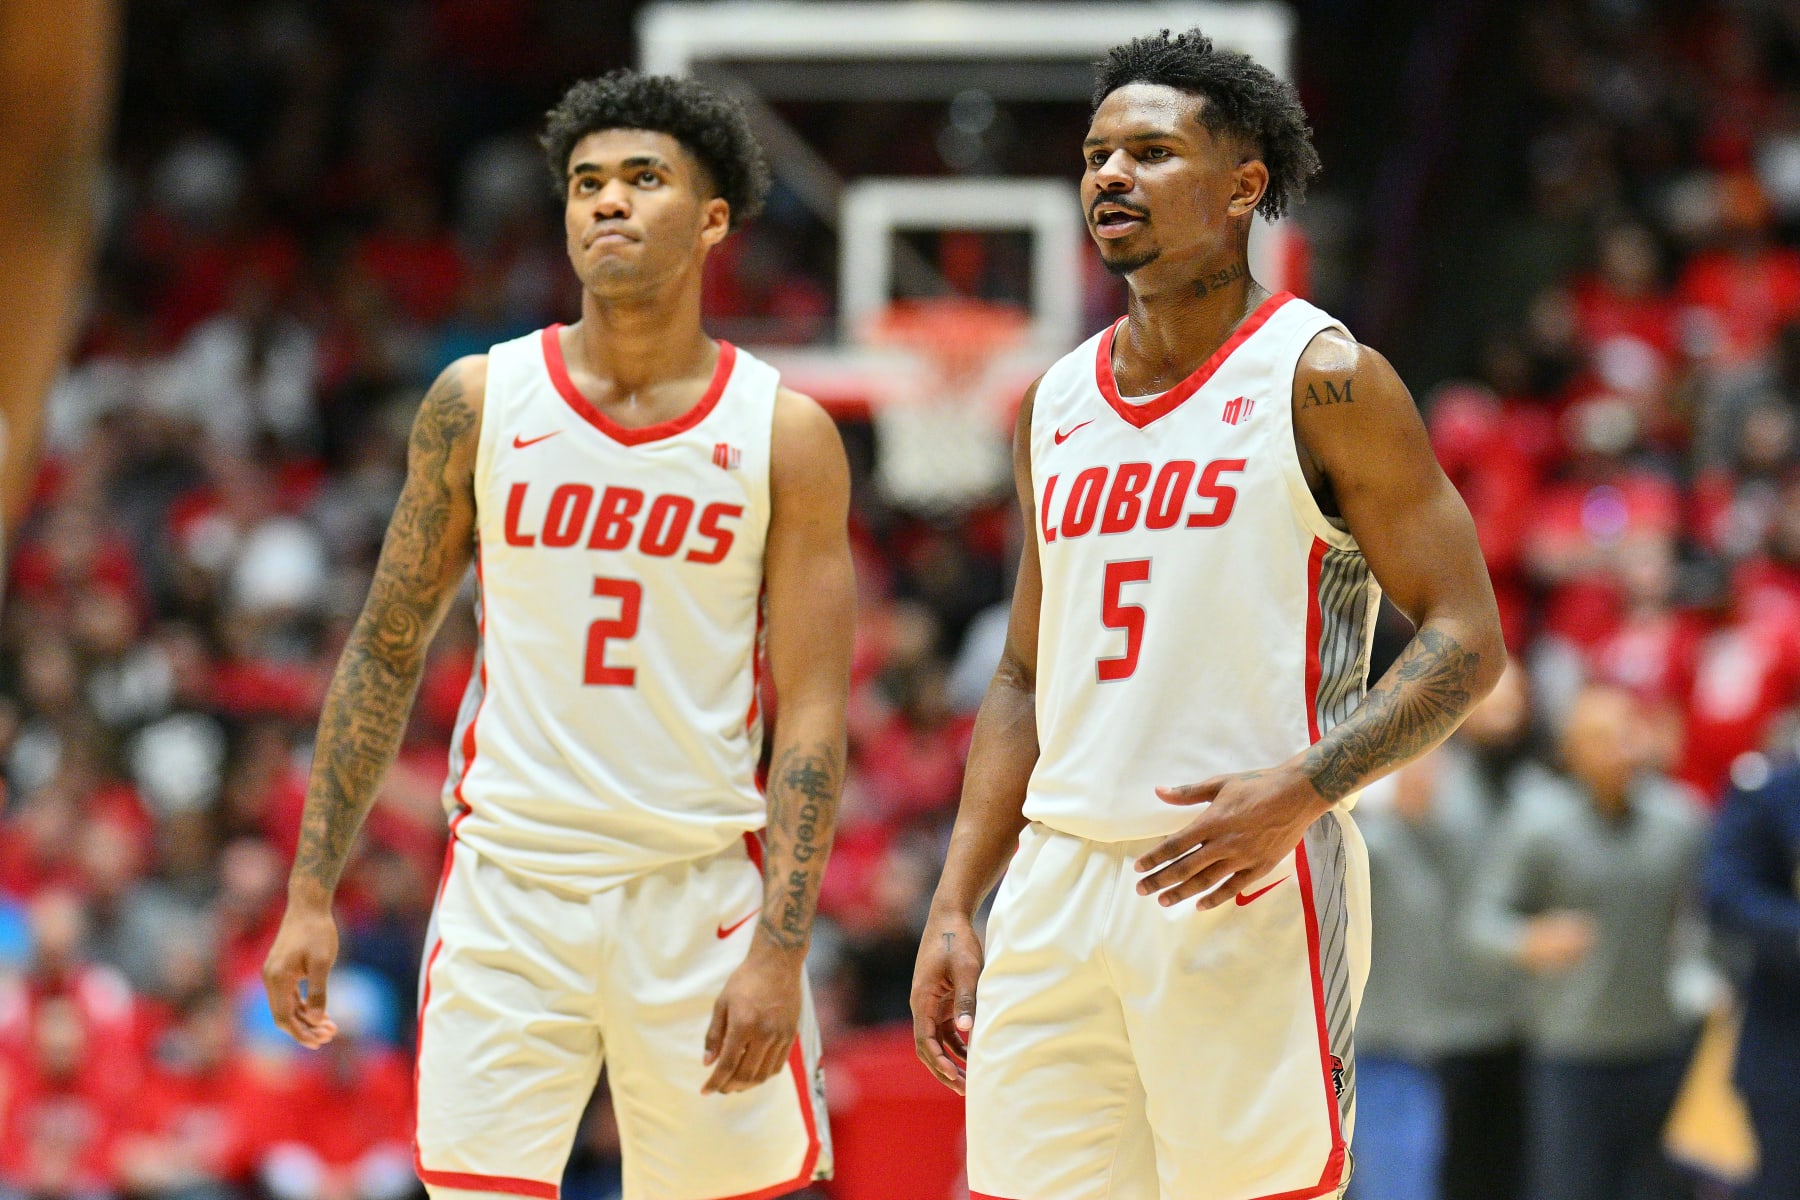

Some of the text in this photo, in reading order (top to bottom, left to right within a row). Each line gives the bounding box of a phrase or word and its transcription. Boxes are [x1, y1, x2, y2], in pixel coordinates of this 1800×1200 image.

[1302, 379, 1354, 409] AM
[504, 482, 744, 564] LOBOS
[1041, 458, 1248, 545] LOBOS
[582, 575, 643, 687] 2
[1095, 556, 1153, 684] 5
[781, 869, 809, 934] FEAR
